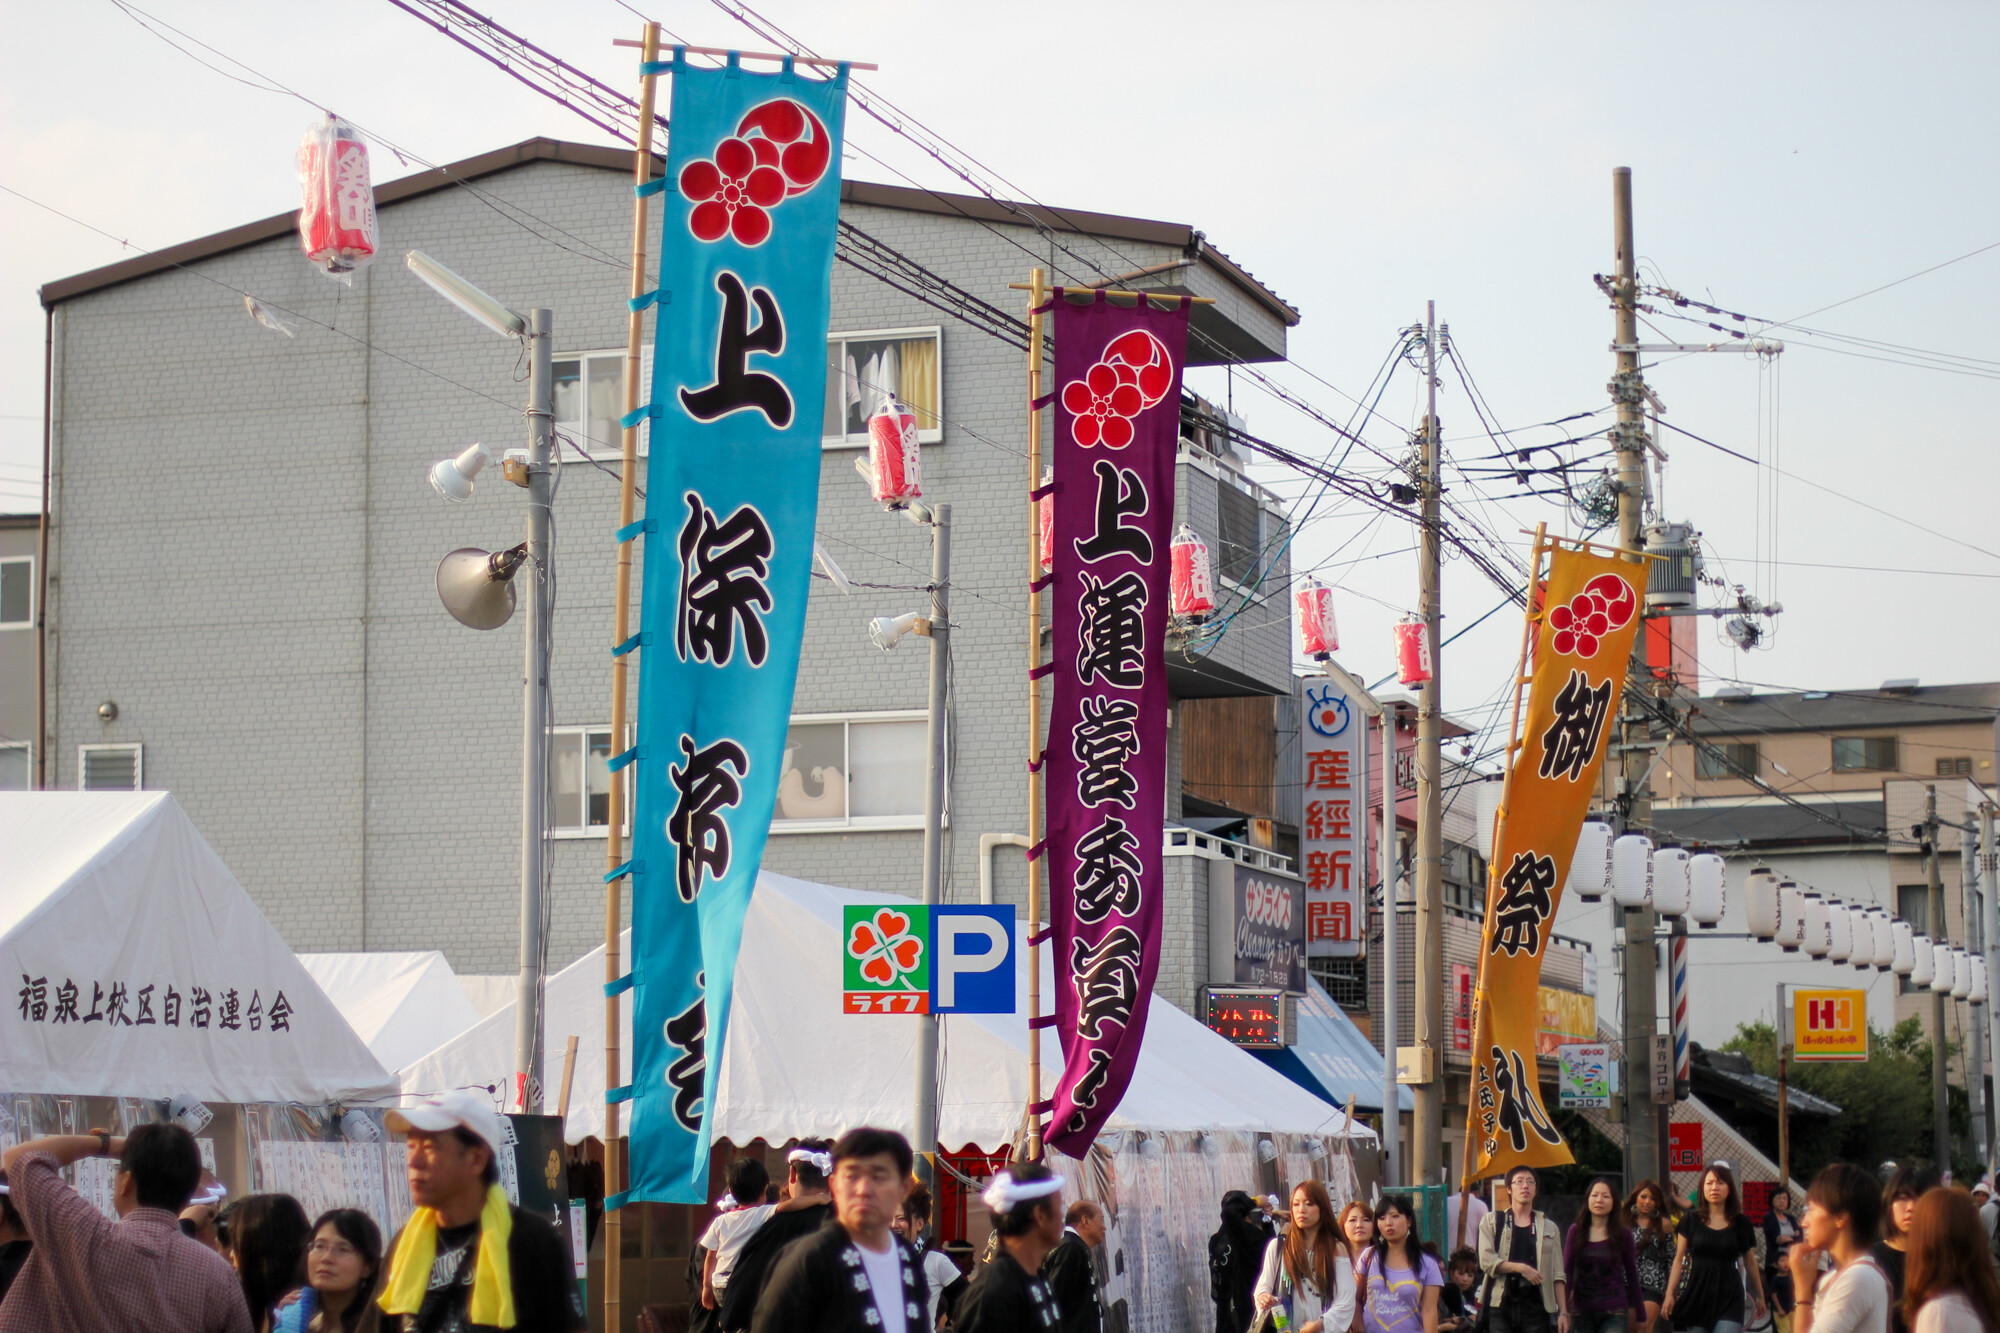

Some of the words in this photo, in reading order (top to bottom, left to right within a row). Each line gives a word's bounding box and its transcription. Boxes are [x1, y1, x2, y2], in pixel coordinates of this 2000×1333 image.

[1306, 749, 1351, 943] 産經新聞
[1490, 668, 1612, 1152] 御祭礼
[18, 974, 294, 1033] 福泉上校区自治連合会
[852, 995, 920, 1012] ライフ
[938, 915, 1009, 1007] P
